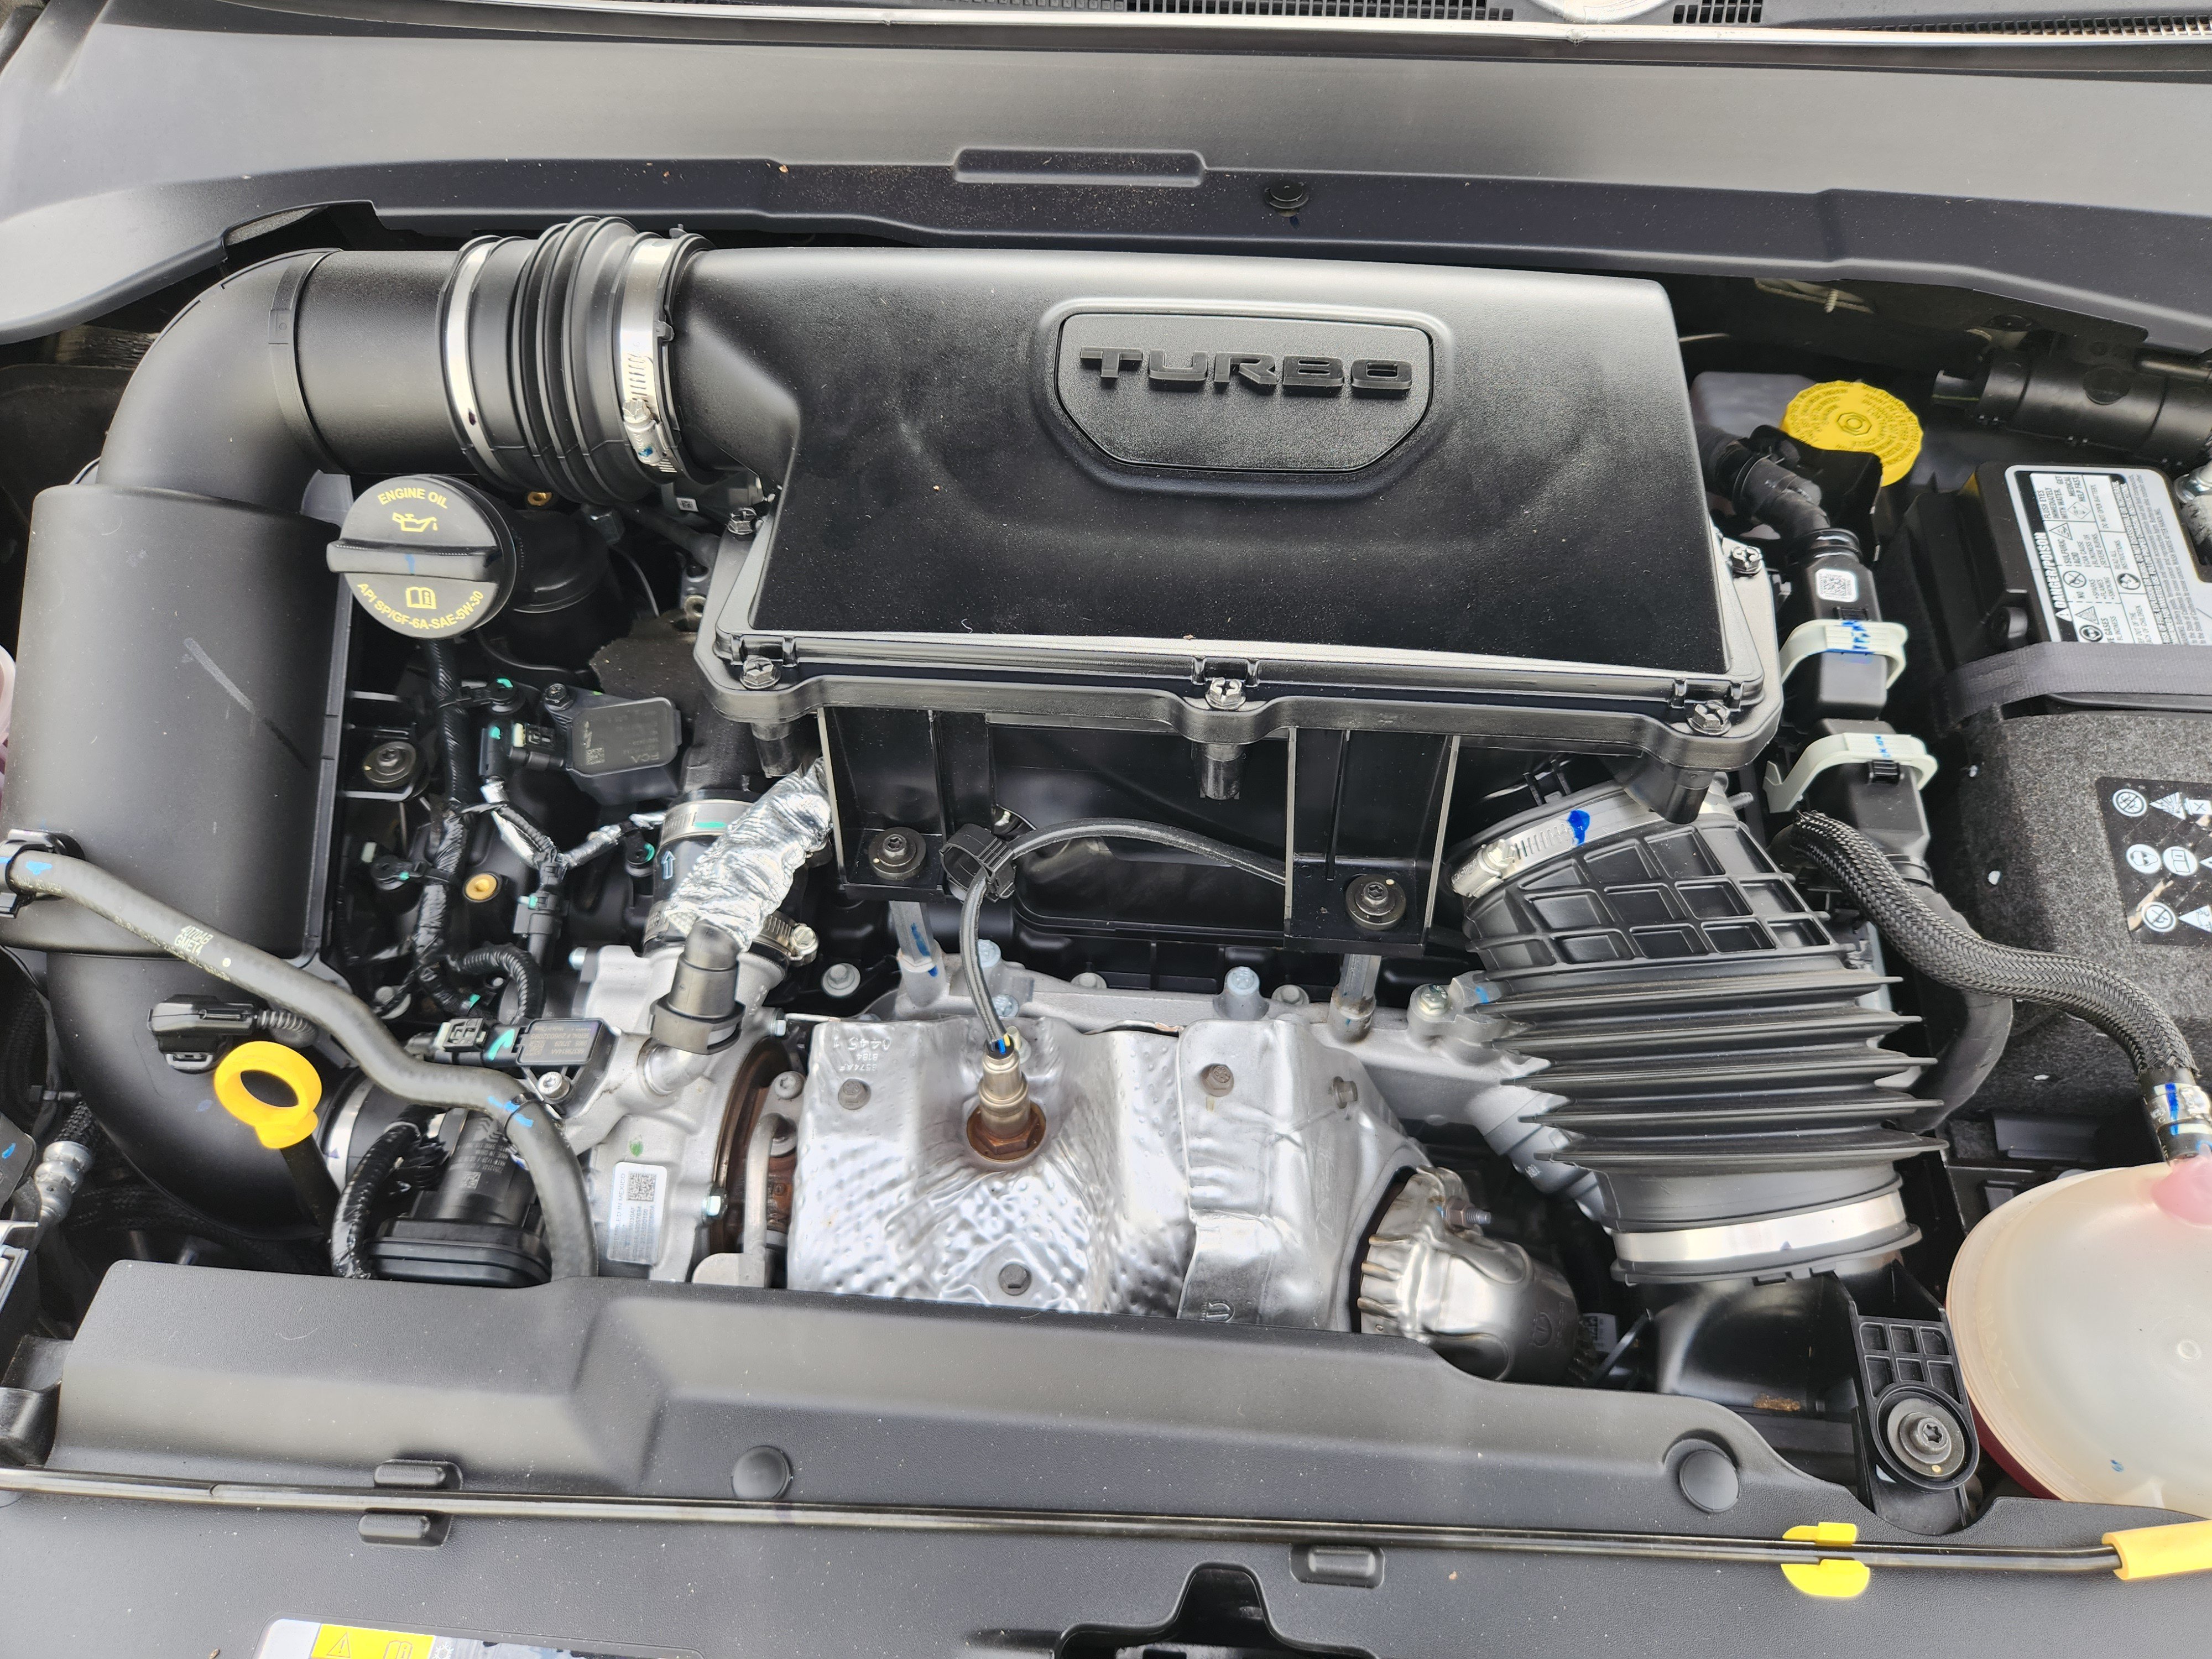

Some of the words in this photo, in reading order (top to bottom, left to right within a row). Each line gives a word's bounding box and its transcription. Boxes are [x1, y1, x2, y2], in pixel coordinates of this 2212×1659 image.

[1080, 347, 1412, 391] TURBO
[2054, 475, 2064, 484] GET
[2063, 476, 2076, 497] MEDICAL
[378, 487, 425, 505] ENGINE
[428, 491, 448, 509] OIL
[2036, 489, 2047, 503] EYES
[2044, 487, 2060, 519] IMMEDIATELY
[2076, 489, 2086, 502] HELP
[2040, 503, 2052, 519] FLUSH
[2058, 507, 2069, 519] WITH
[2057, 538, 2072, 564] SULFURIC
[2076, 540, 2087, 554] CAUSE
[2085, 541, 2098, 564] BLINDNESS
[2070, 551, 2081, 564] ACID
[2081, 555, 2090, 564] CAN
[2096, 549, 2107, 565] SEVERE
[2032, 531, 2067, 608] DANGER/POISON
[357, 583, 378, 603] API
[2100, 617, 2112, 635] GASES
[631, 752, 659, 763] FCA
[181, 925, 214, 945] 4070AB
[175, 934, 204, 956] GMET4
